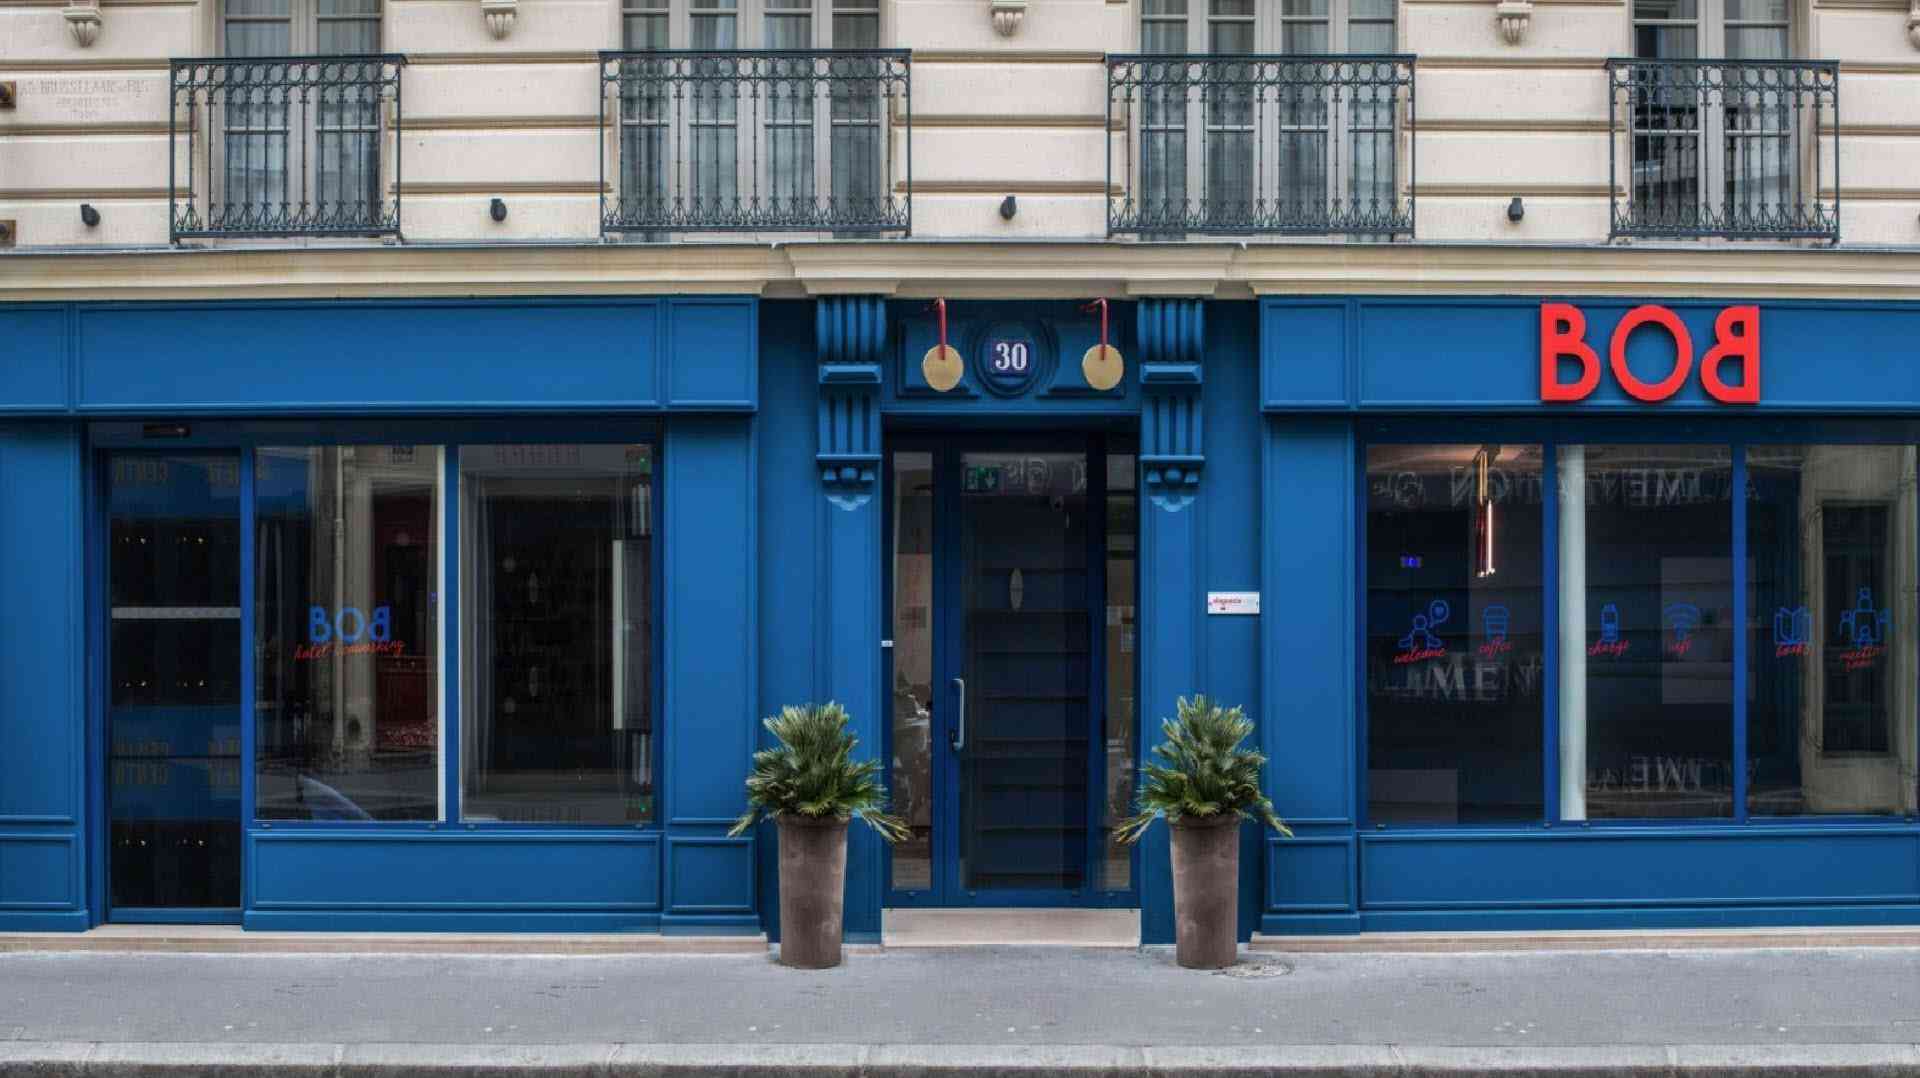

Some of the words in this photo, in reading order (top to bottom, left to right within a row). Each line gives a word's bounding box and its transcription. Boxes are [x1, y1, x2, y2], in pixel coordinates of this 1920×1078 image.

[995, 342, 1027, 370] 30
[1540, 303, 1760, 404] BOB
[309, 606, 390, 641] BOB
[1394, 646, 1446, 664] welcome
[1480, 636, 1513, 660] coffee
